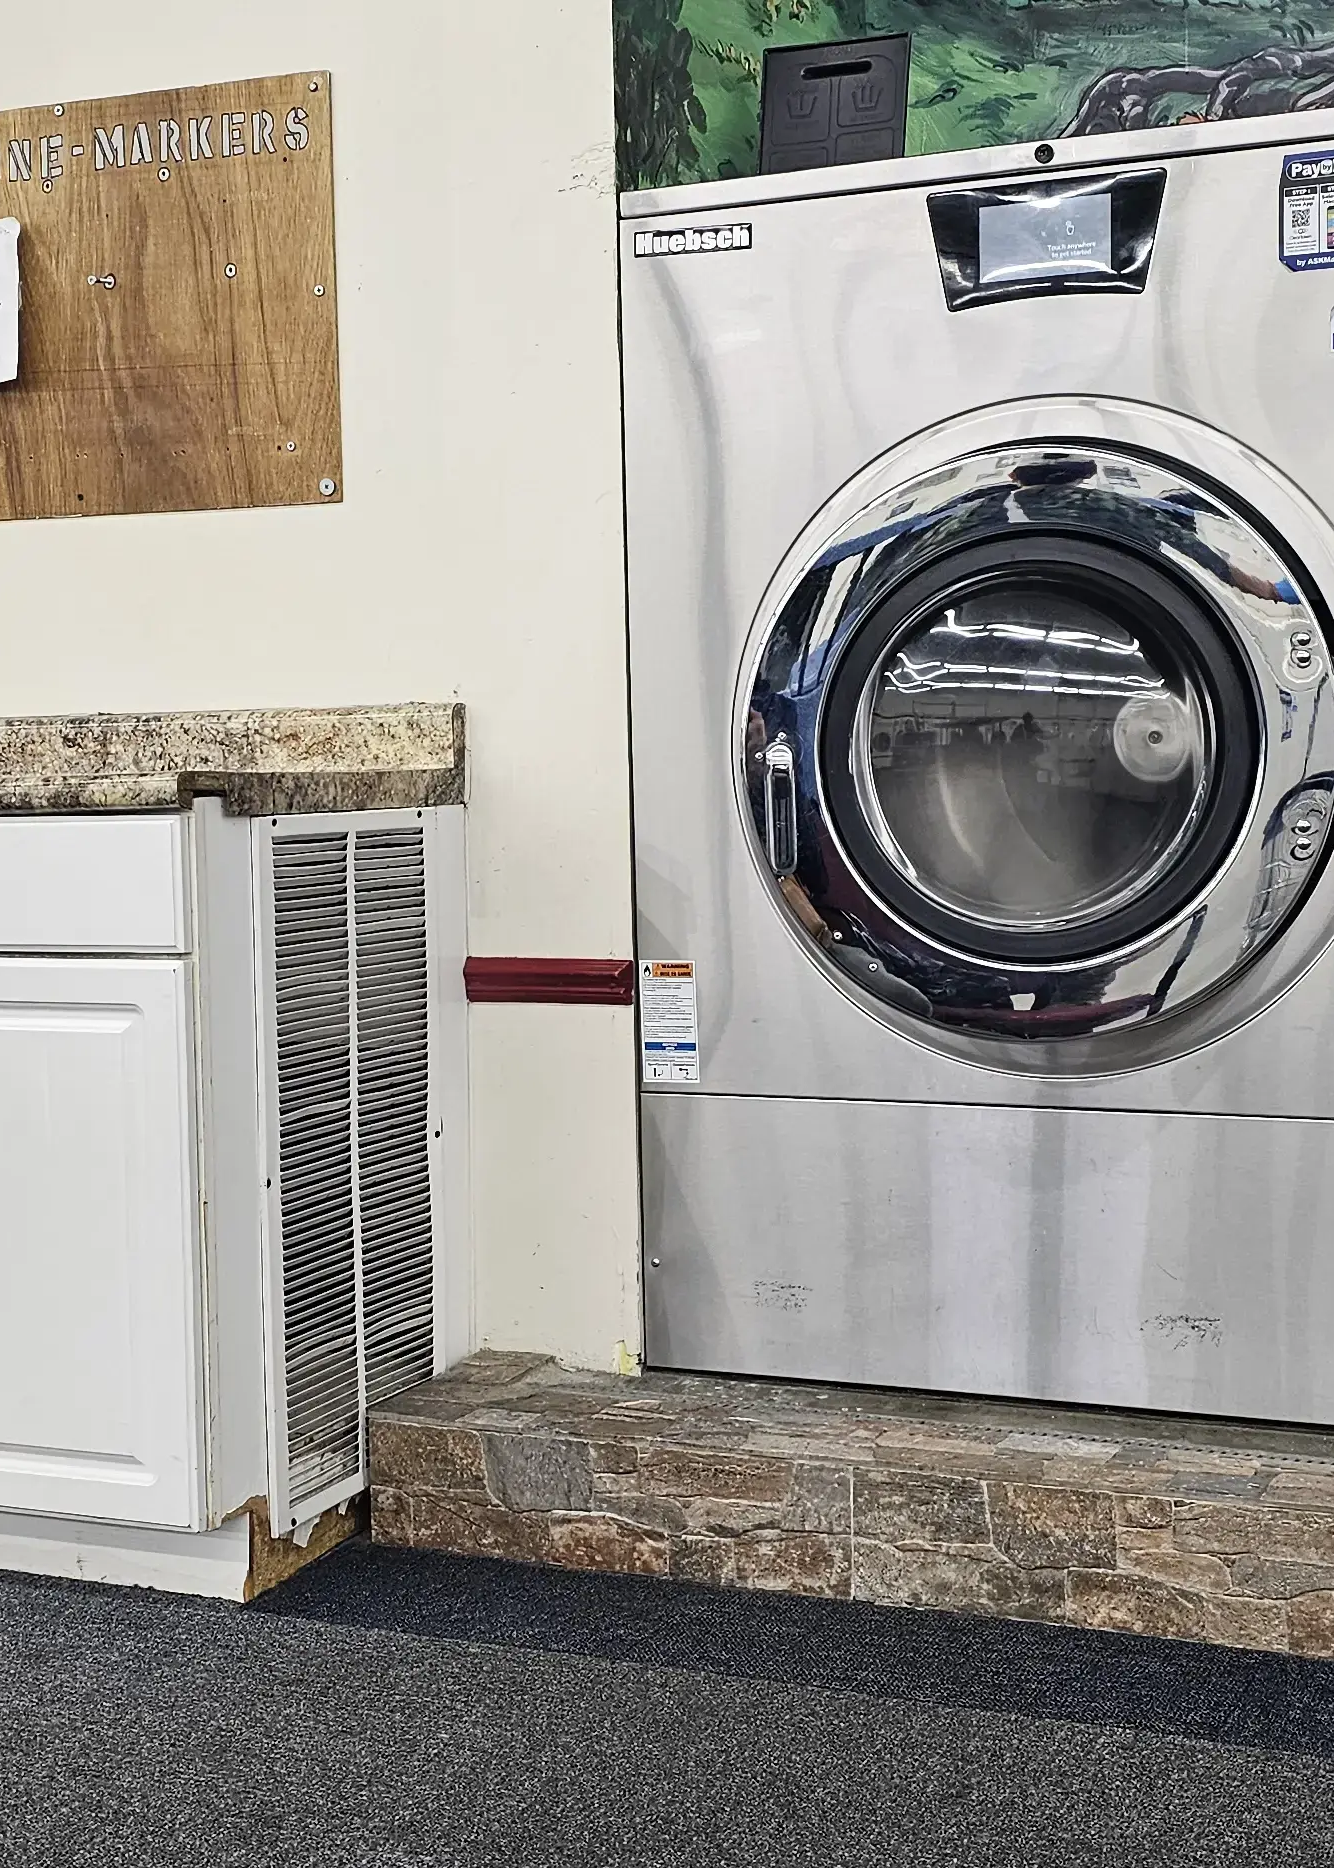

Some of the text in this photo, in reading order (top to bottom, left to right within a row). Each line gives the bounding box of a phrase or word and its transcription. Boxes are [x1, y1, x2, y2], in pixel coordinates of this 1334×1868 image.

[1291, 162, 1321, 178] Pay
[1322, 163, 1331, 171] by
[635, 227, 750, 255] Huebsch
[1067, 241, 1096, 250] anywhere
[1296, 259, 1306, 267] by
